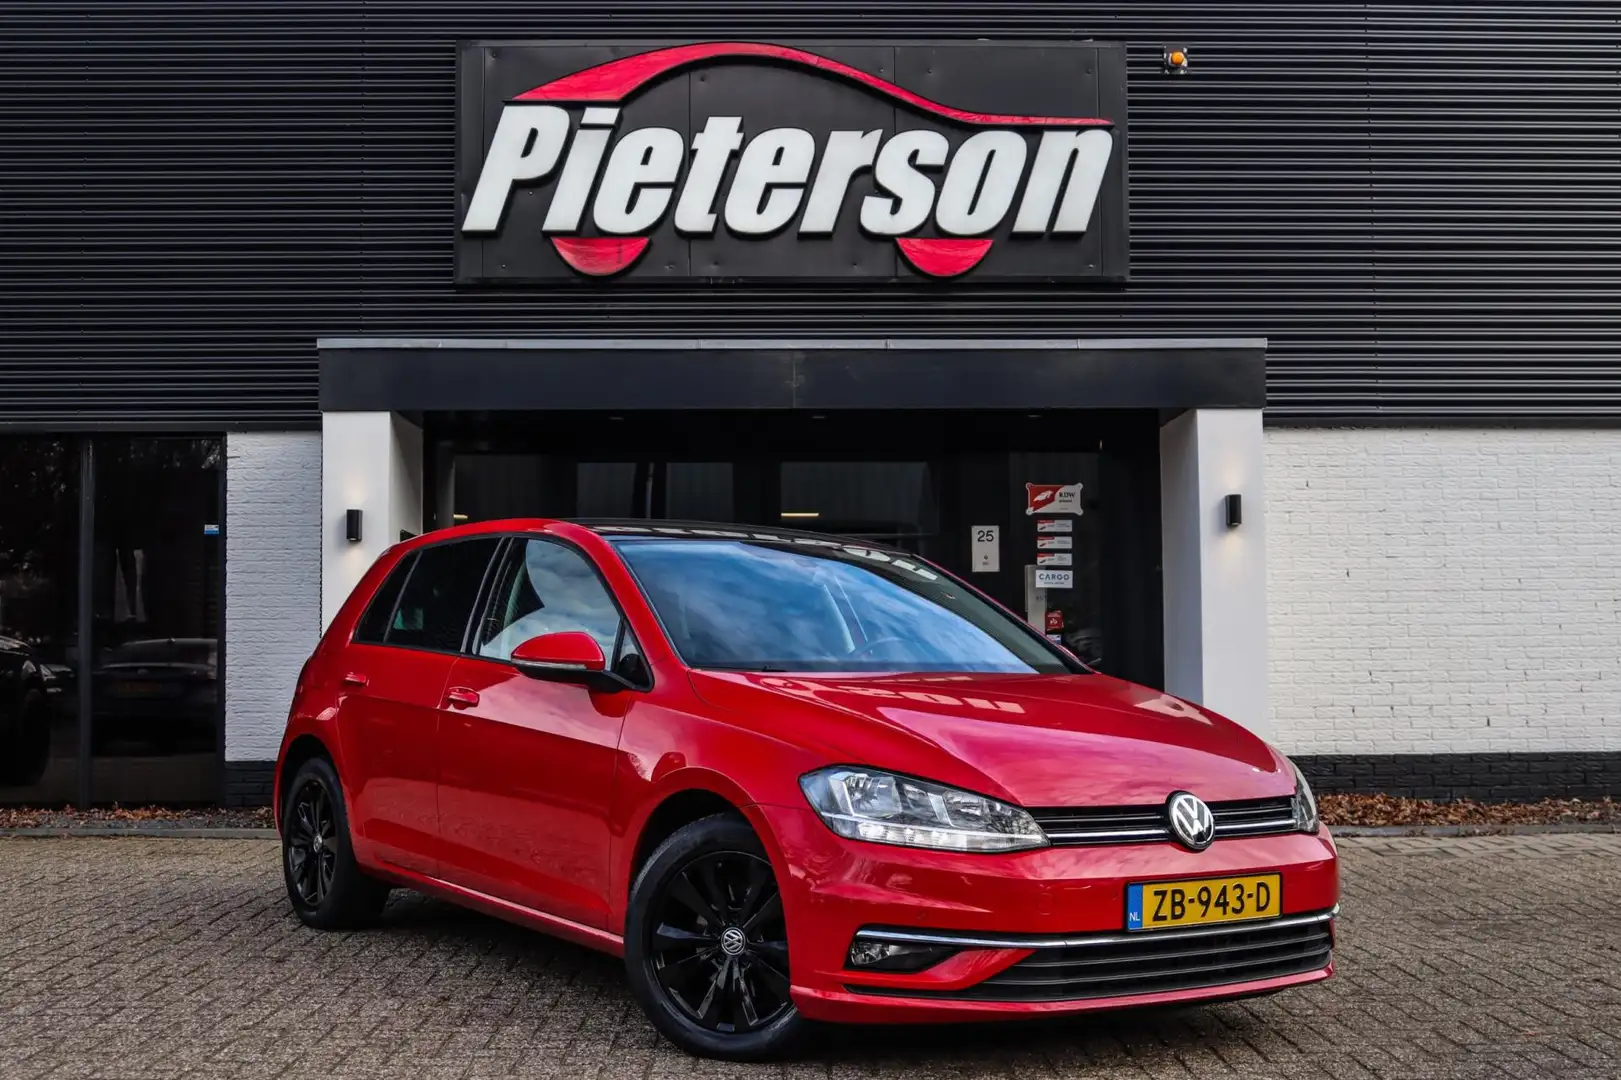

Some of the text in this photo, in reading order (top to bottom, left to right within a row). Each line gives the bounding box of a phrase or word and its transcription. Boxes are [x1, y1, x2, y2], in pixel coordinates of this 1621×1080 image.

[462, 105, 1114, 234] Pieterson
[977, 530, 994, 542] 25
[1152, 881, 1271, 922] ZB-943-D
[1129, 912, 1141, 921] NL
